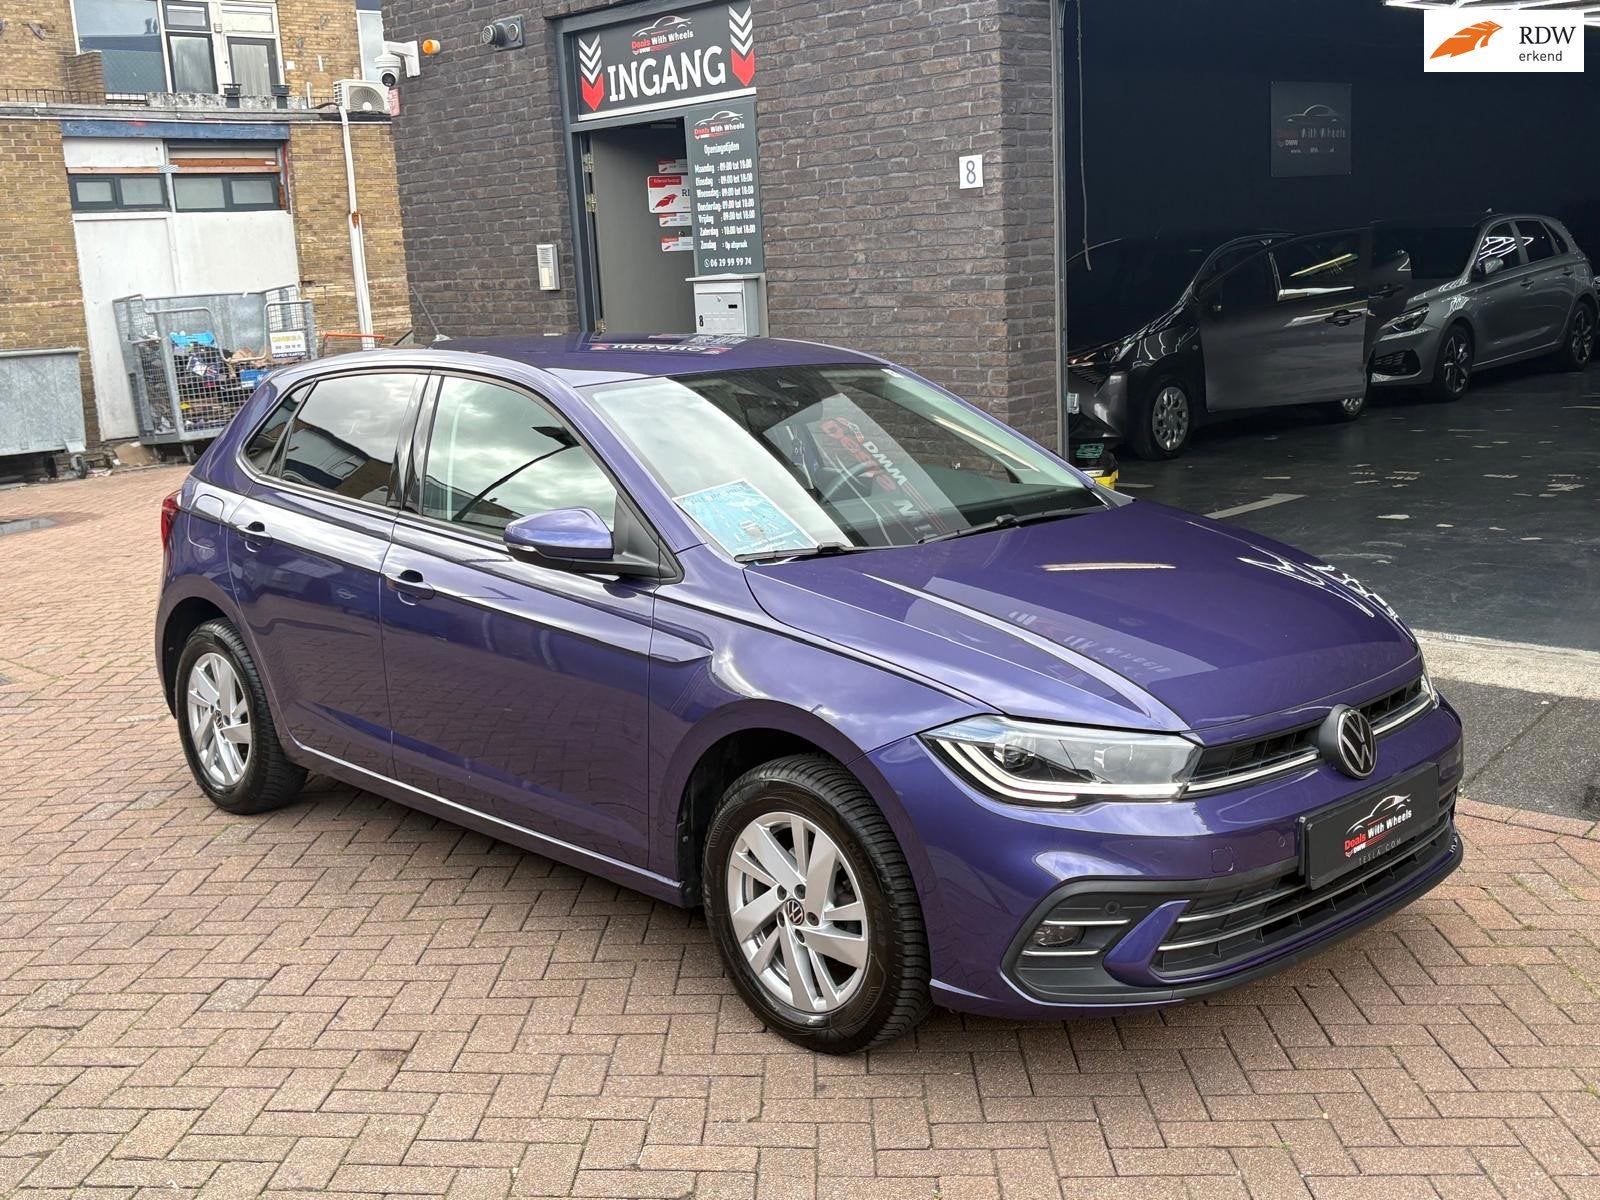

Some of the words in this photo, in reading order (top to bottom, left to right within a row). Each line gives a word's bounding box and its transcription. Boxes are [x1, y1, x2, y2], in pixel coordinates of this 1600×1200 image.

[651, 34, 668, 46] With
[668, 29, 694, 43] Wheels
[607, 45, 727, 102] INGANG
[966, 160, 976, 185] 8
[710, 258, 718, 268] 06
[727, 257, 735, 267] 99
[736, 257, 744, 266] 99
[744, 256, 752, 266] 74
[1344, 832, 1367, 851] Deals
[1367, 822, 1385, 839] With
[1386, 809, 1412, 829] Wheels
